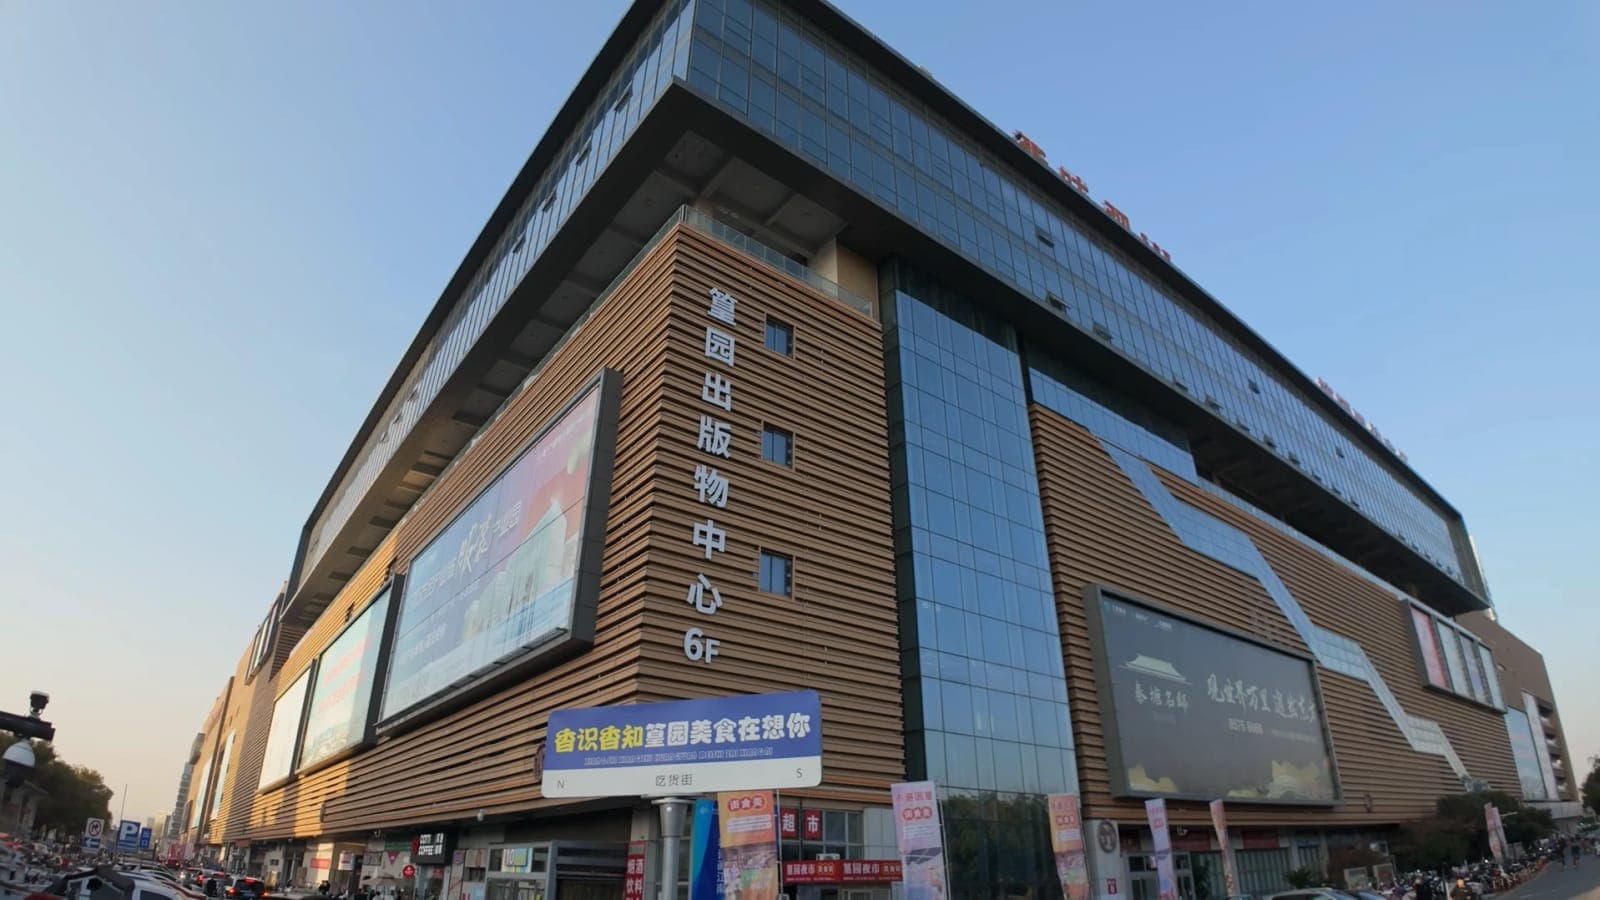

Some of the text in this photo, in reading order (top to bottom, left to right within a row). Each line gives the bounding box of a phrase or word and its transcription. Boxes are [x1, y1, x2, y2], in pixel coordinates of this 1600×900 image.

[686, 288, 738, 615] 篁园出版物中心
[683, 627, 721, 665] 6F
[554, 712, 811, 753] 香识香知篁园美食在想你
[655, 773, 693, 787] 吃货街
[796, 768, 803, 779] S
[556, 780, 565, 789] N
[782, 813, 820, 834] 超市
